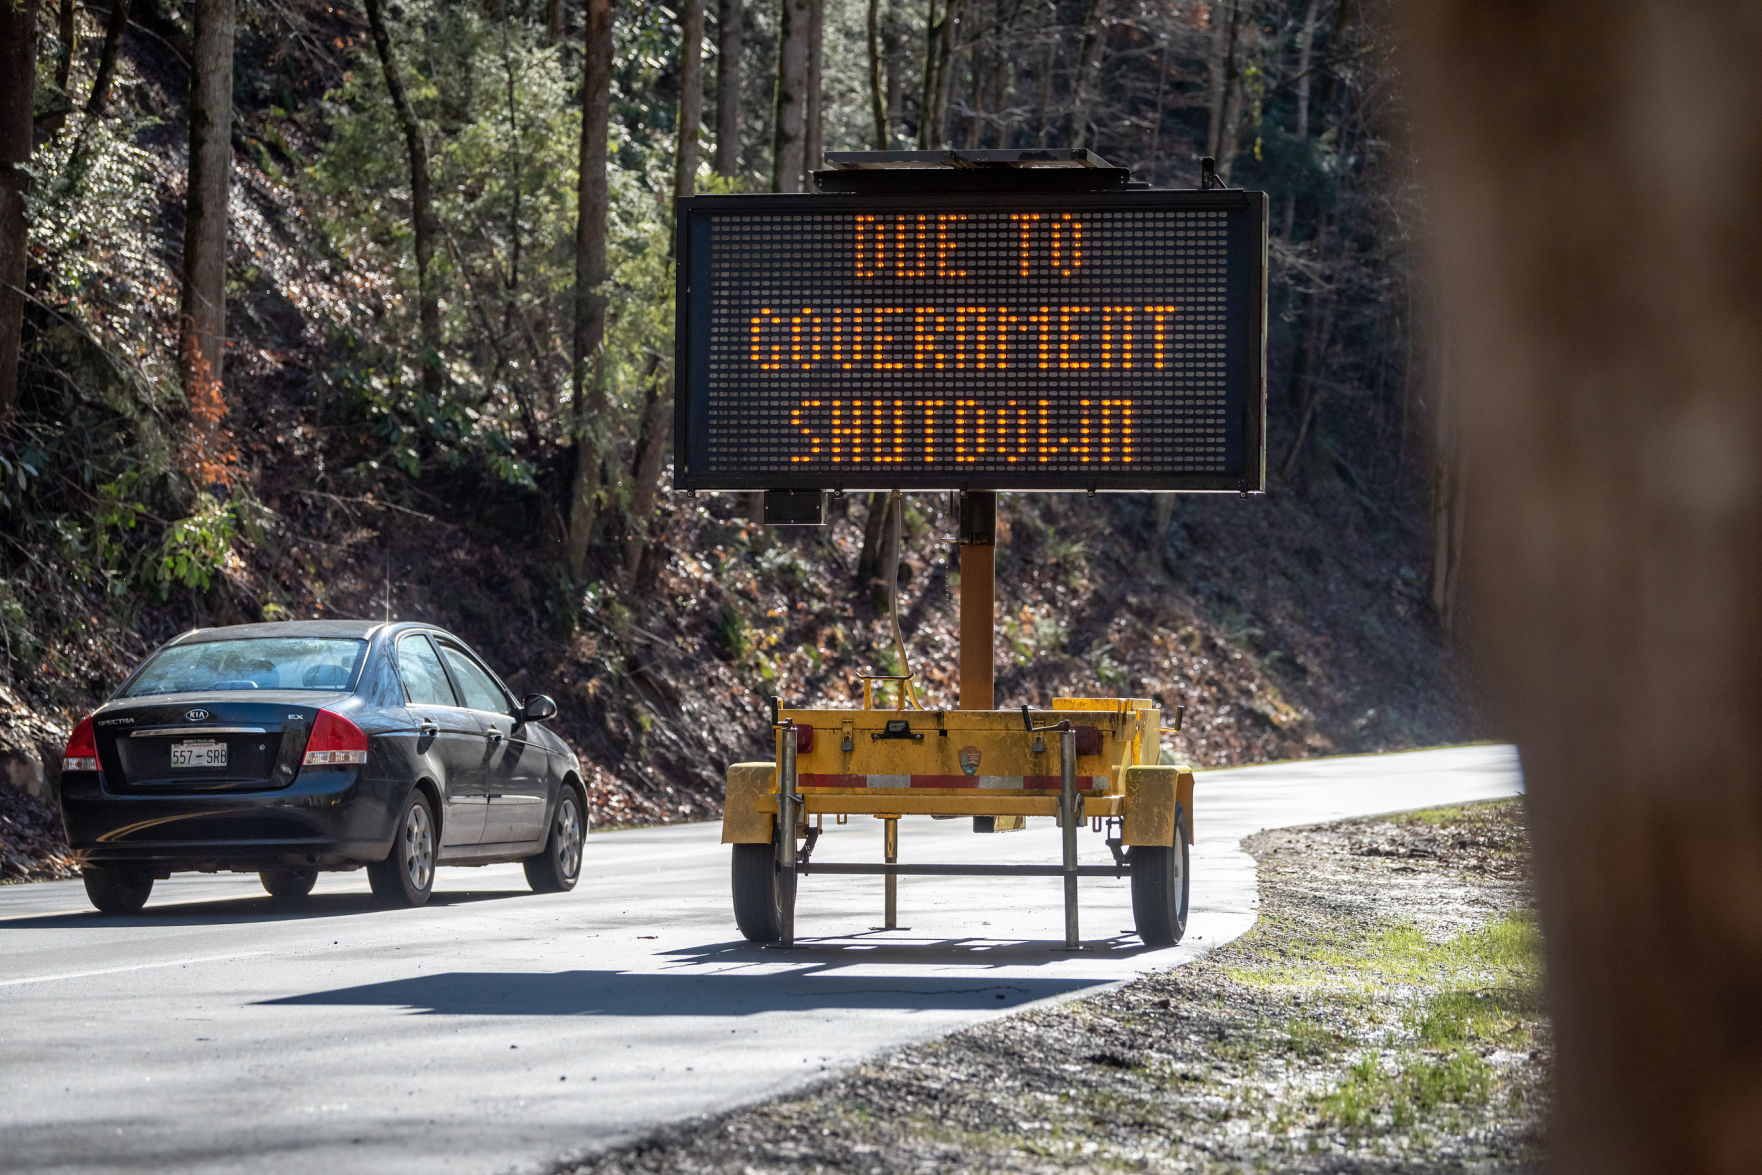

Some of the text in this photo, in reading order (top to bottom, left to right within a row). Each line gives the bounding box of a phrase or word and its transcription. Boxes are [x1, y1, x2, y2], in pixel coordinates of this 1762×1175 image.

[856, 213, 1082, 278] DUE TO
[750, 305, 1175, 370] GOVERNMENT
[791, 399, 1134, 463] SHUTDOWN
